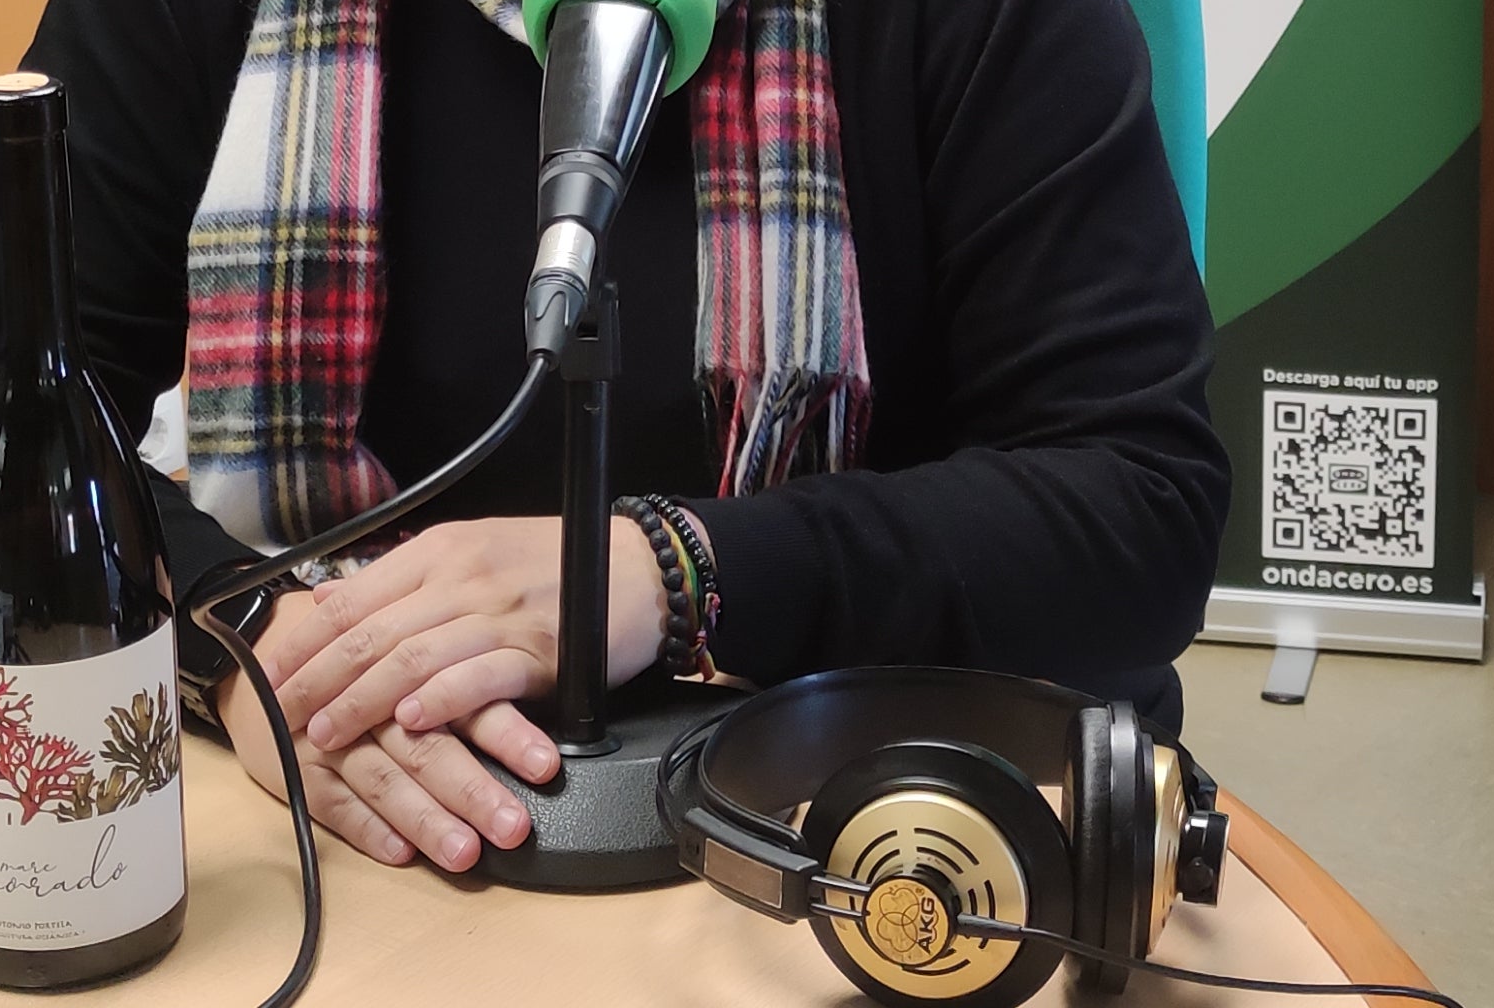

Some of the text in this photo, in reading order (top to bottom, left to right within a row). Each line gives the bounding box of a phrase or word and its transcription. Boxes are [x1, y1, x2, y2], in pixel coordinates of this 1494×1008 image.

[1262, 368, 1439, 393] Descarga aquí tu app
[1261, 564, 1434, 595] ondacero.es
[917, 896, 935, 955] AKG
